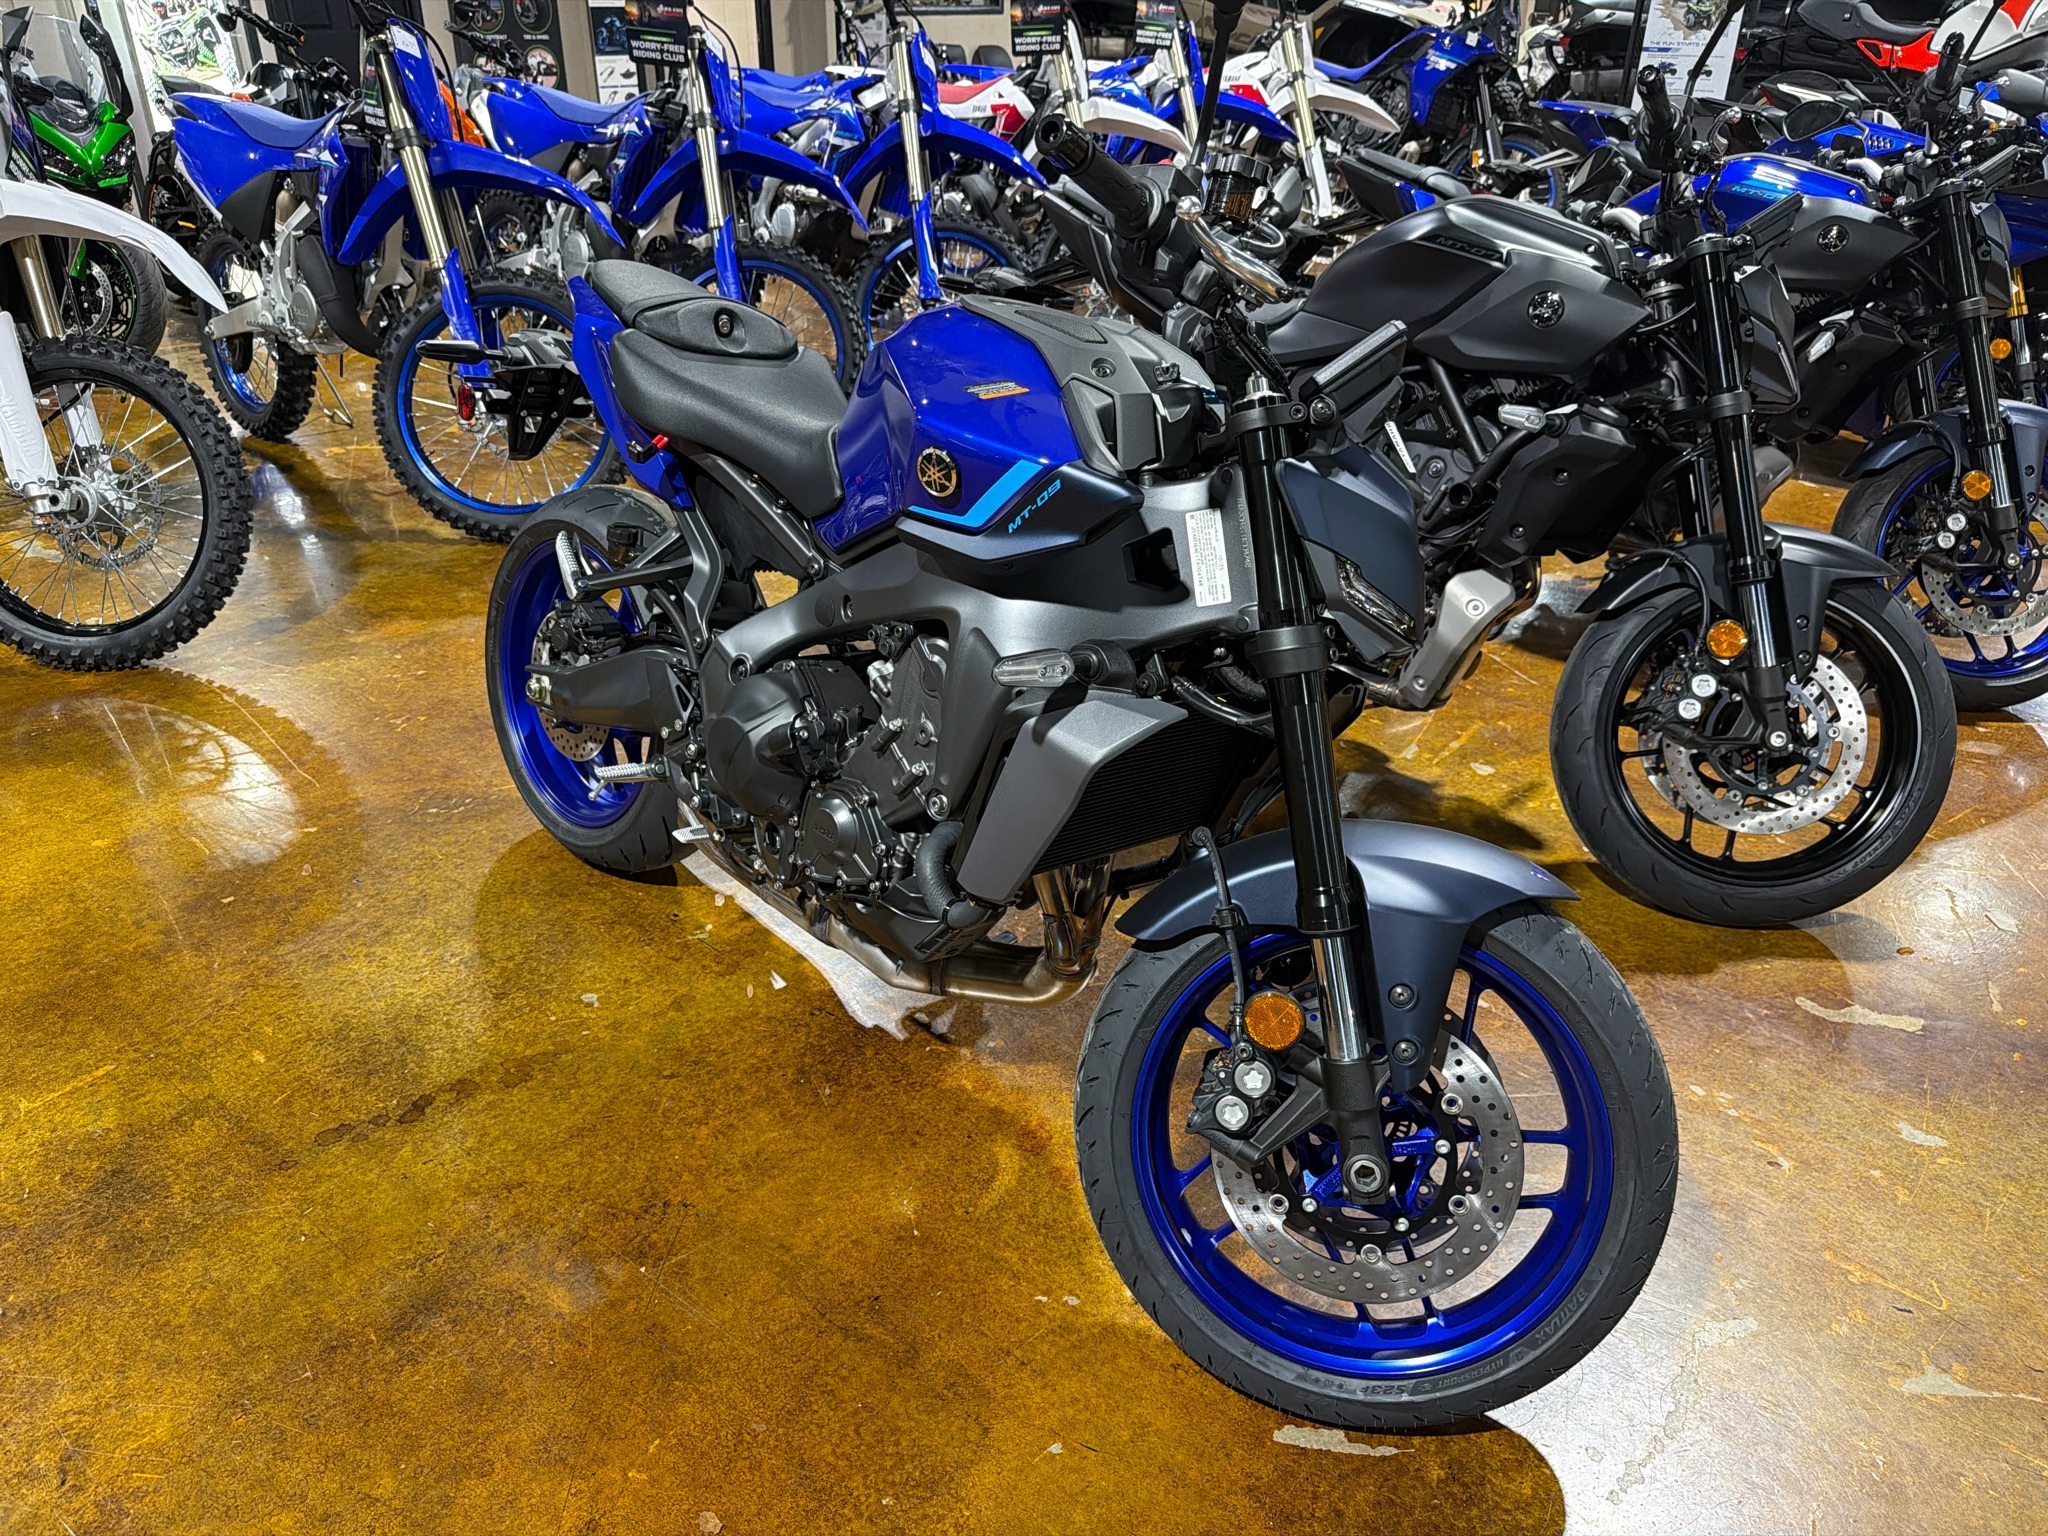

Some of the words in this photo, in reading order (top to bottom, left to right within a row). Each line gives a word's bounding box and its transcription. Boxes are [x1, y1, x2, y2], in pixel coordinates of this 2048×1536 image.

[630, 40, 686, 54] WORRY-FREE
[1014, 35, 1062, 45] WORRY-FREE
[1015, 44, 1041, 52] RIDING
[632, 49, 662, 61] RIDING
[662, 51, 686, 63] CLUB
[1731, 185, 1788, 200] MT-0
[1436, 237, 1502, 260] MT-07
[0, 395, 42, 458] YAMAHA
[1008, 478, 1062, 534] MT-09
[1535, 1287, 1588, 1345] BATTLAX
[1438, 1358, 1504, 1388] HYPERSPORT
[1361, 1384, 1407, 1396] S23F
